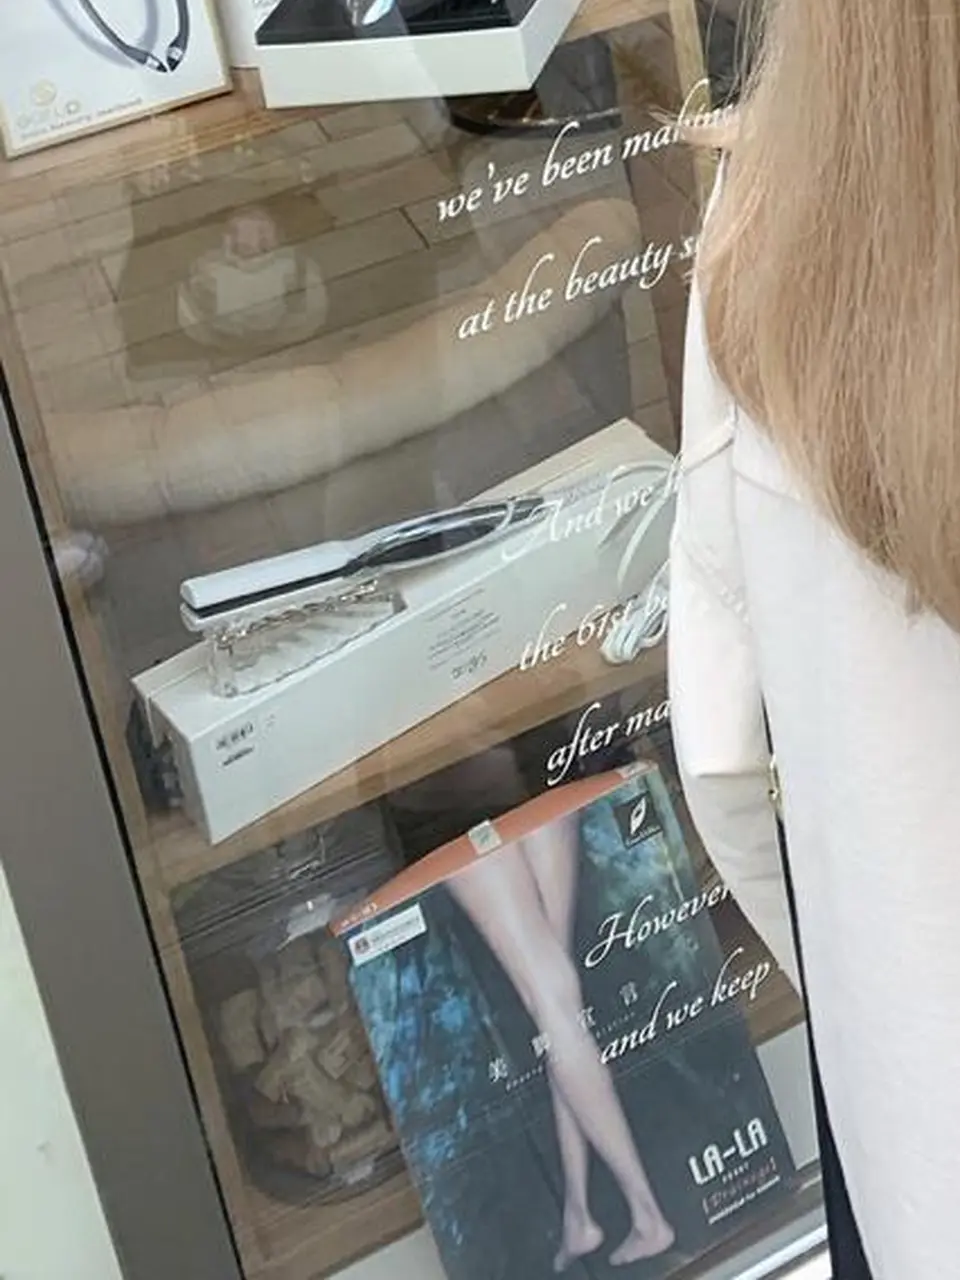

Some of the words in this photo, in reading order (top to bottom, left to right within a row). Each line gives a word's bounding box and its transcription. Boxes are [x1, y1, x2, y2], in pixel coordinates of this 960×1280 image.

[436, 162, 530, 221] we've
[542, 121, 612, 187] been
[459, 299, 495, 340] at
[504, 253, 555, 324] the
[564, 236, 672, 301] beauty
[501, 465, 626, 561] And
[615, 485, 654, 519] we
[519, 602, 567, 671] the
[546, 702, 620, 786] after
[600, 981, 678, 1064] and
[666, 997, 704, 1031] we
[711, 946, 770, 1008] keep
[688, 1117, 768, 1185] LA-LA
